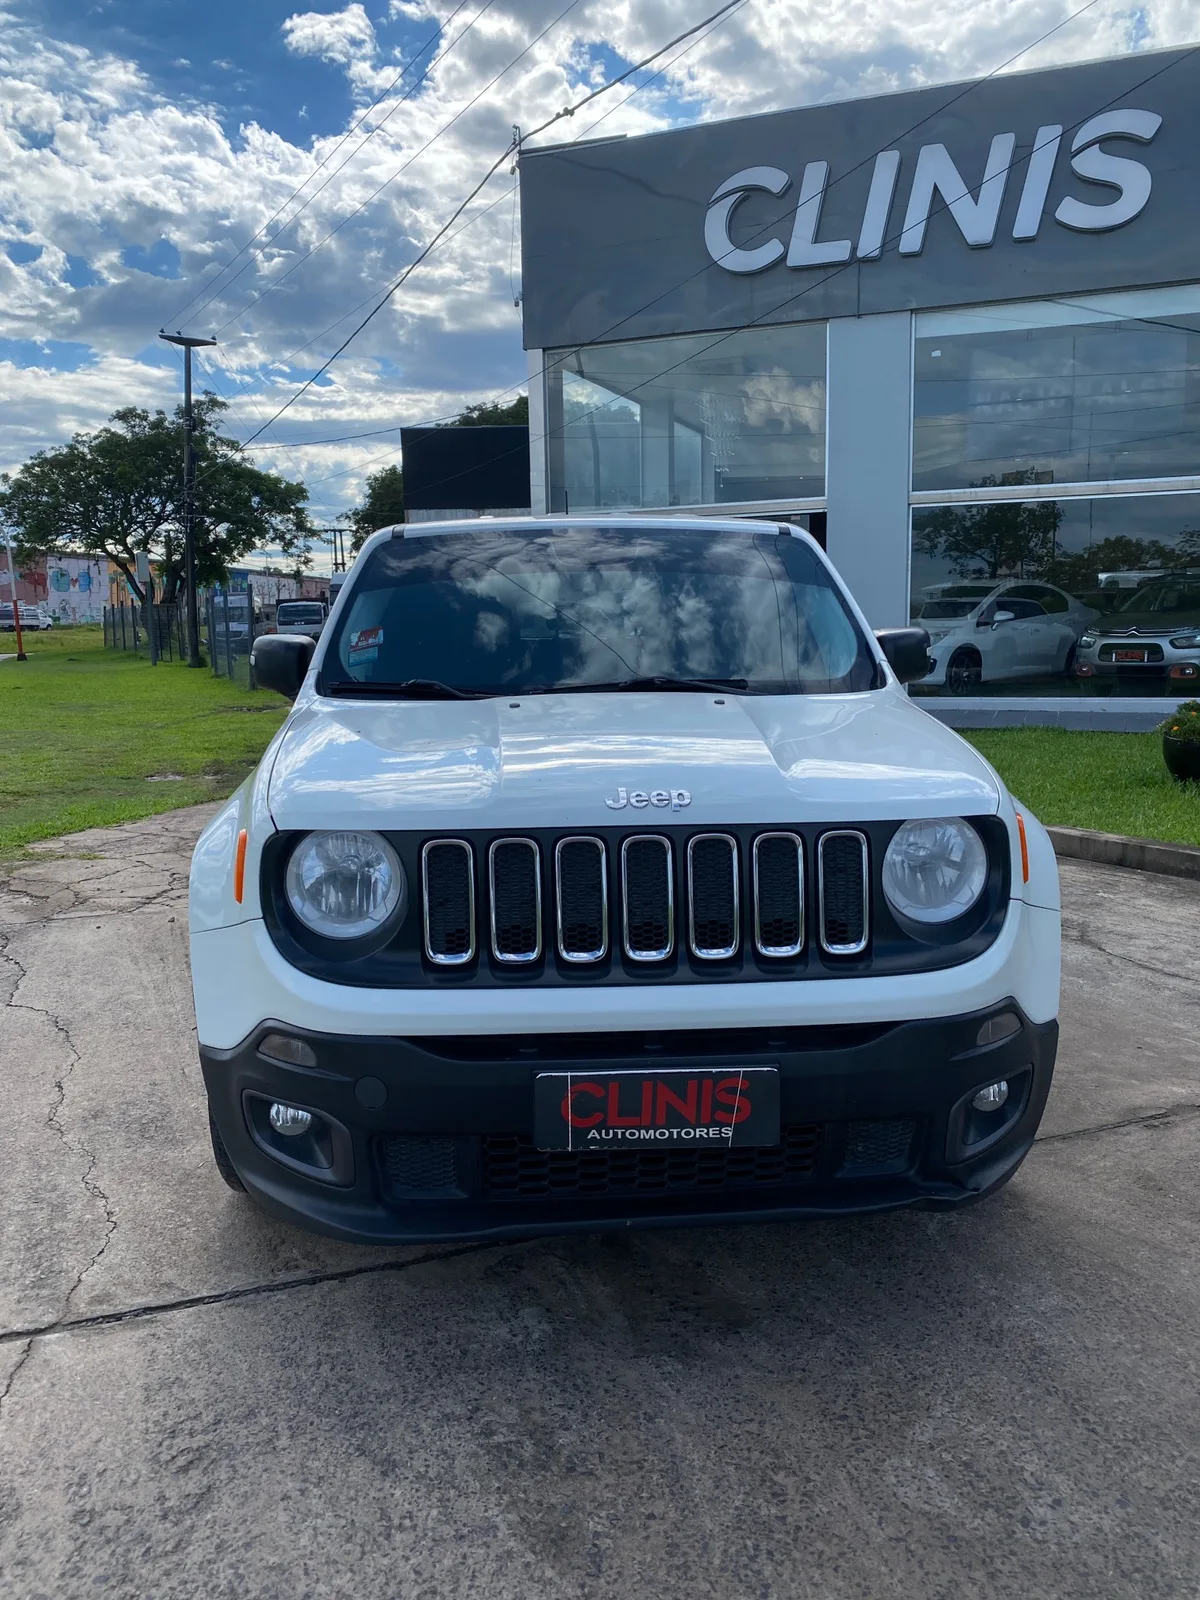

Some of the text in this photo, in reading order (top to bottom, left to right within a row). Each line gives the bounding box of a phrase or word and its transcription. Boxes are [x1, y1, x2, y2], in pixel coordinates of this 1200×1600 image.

[704, 108, 1163, 274] CLINIS
[605, 787, 692, 812] Jeep
[561, 1077, 751, 1128] CLINIS
[587, 1127, 732, 1139] AUTOMOTORES
